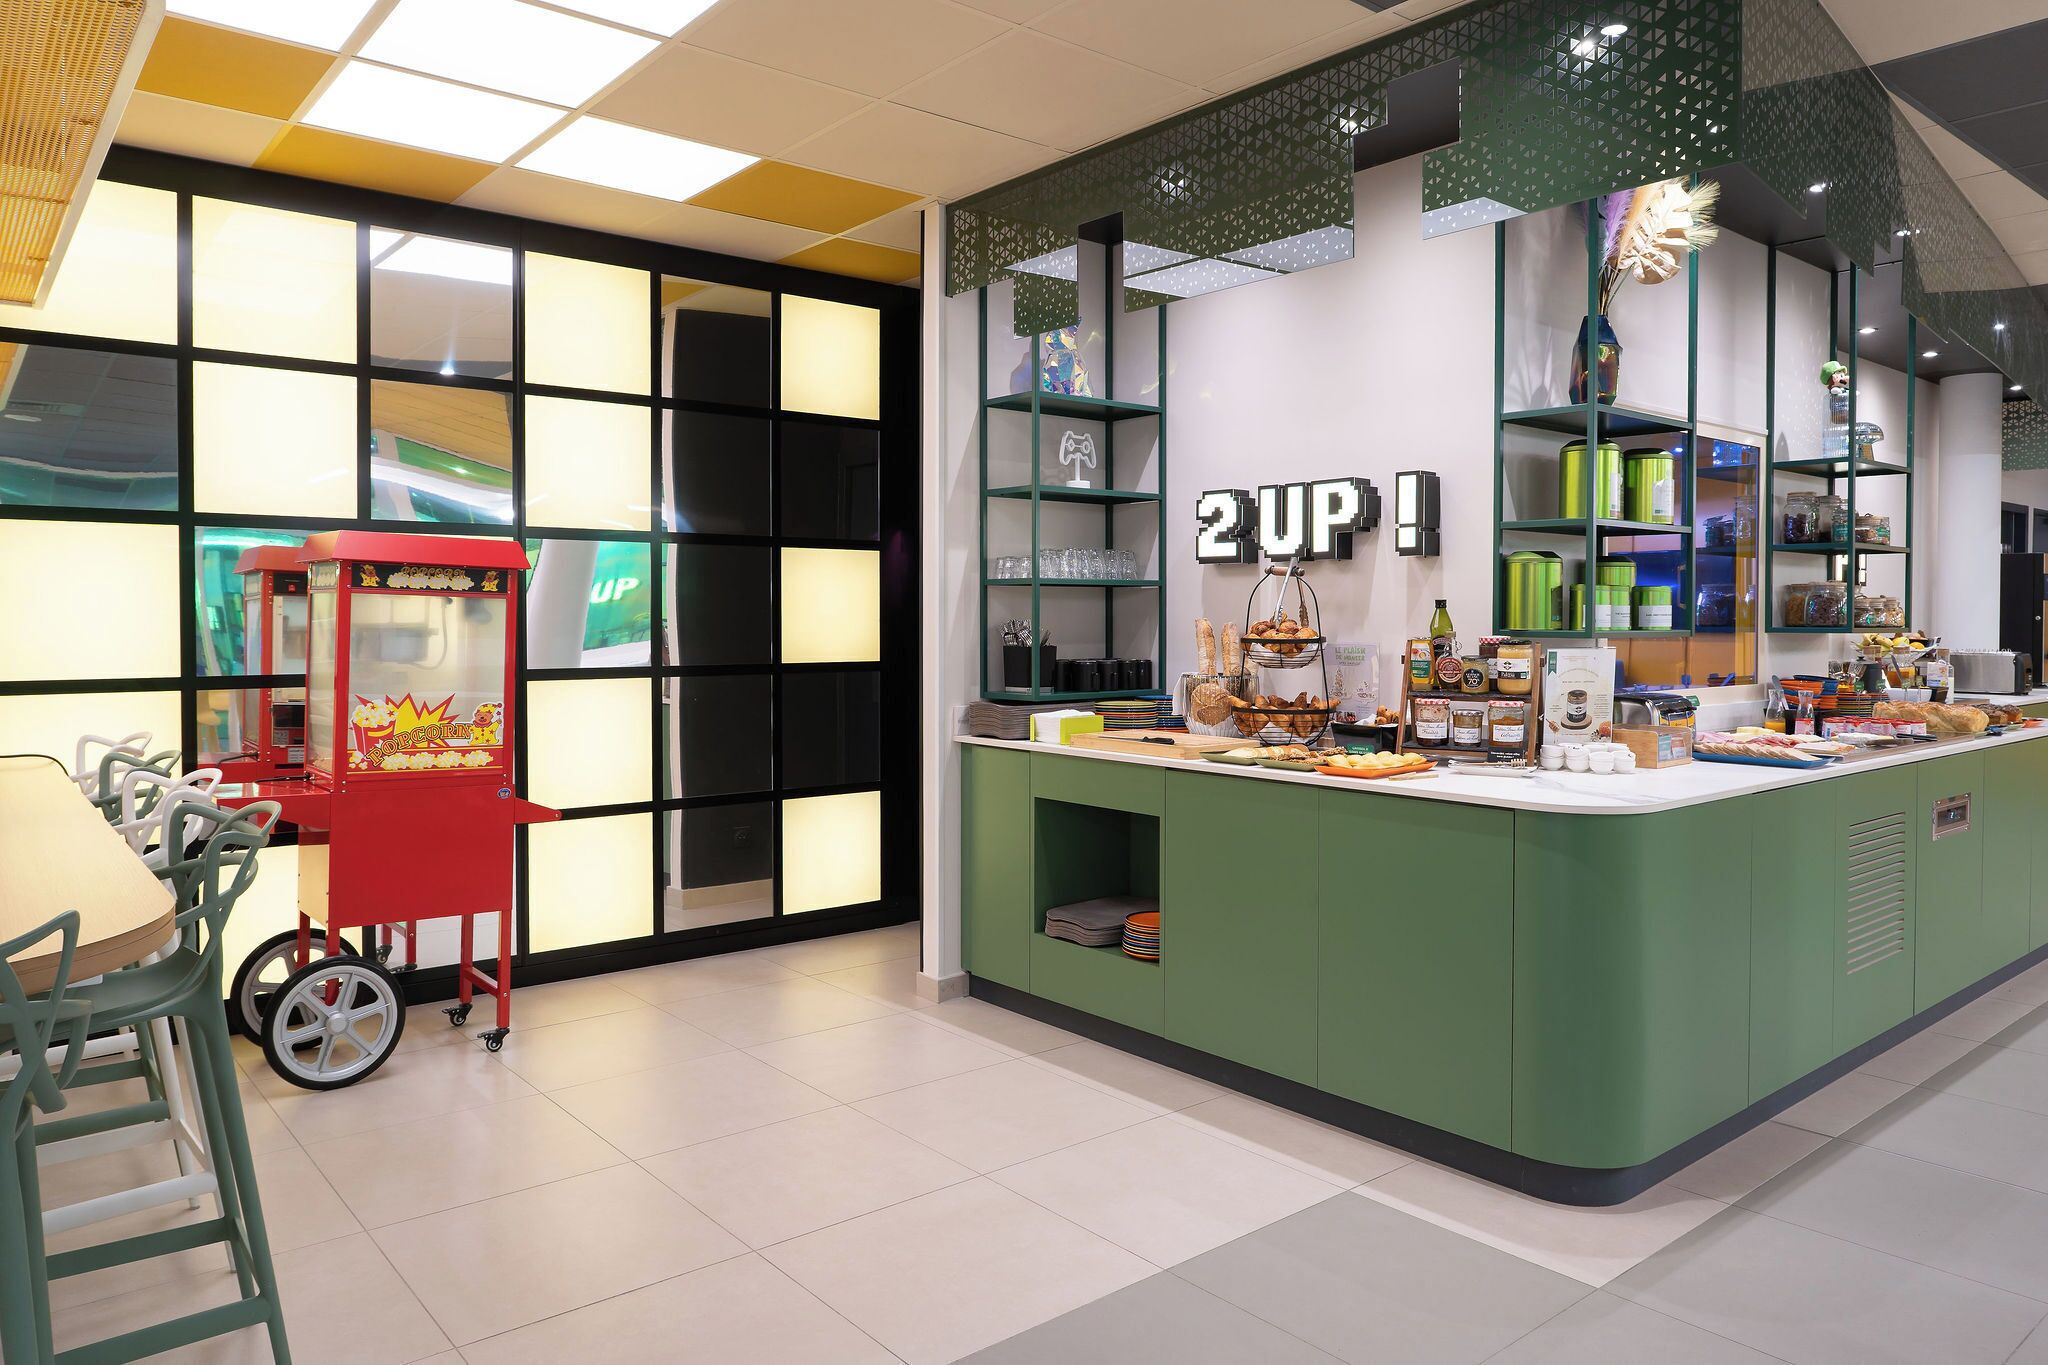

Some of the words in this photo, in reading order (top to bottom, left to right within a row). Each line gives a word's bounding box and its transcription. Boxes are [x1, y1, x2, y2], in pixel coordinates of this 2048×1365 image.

[1196, 490, 1244, 564] 2
[1258, 479, 1366, 561] UP
[590, 578, 640, 603] UP
[365, 722, 472, 767] POPCORN
